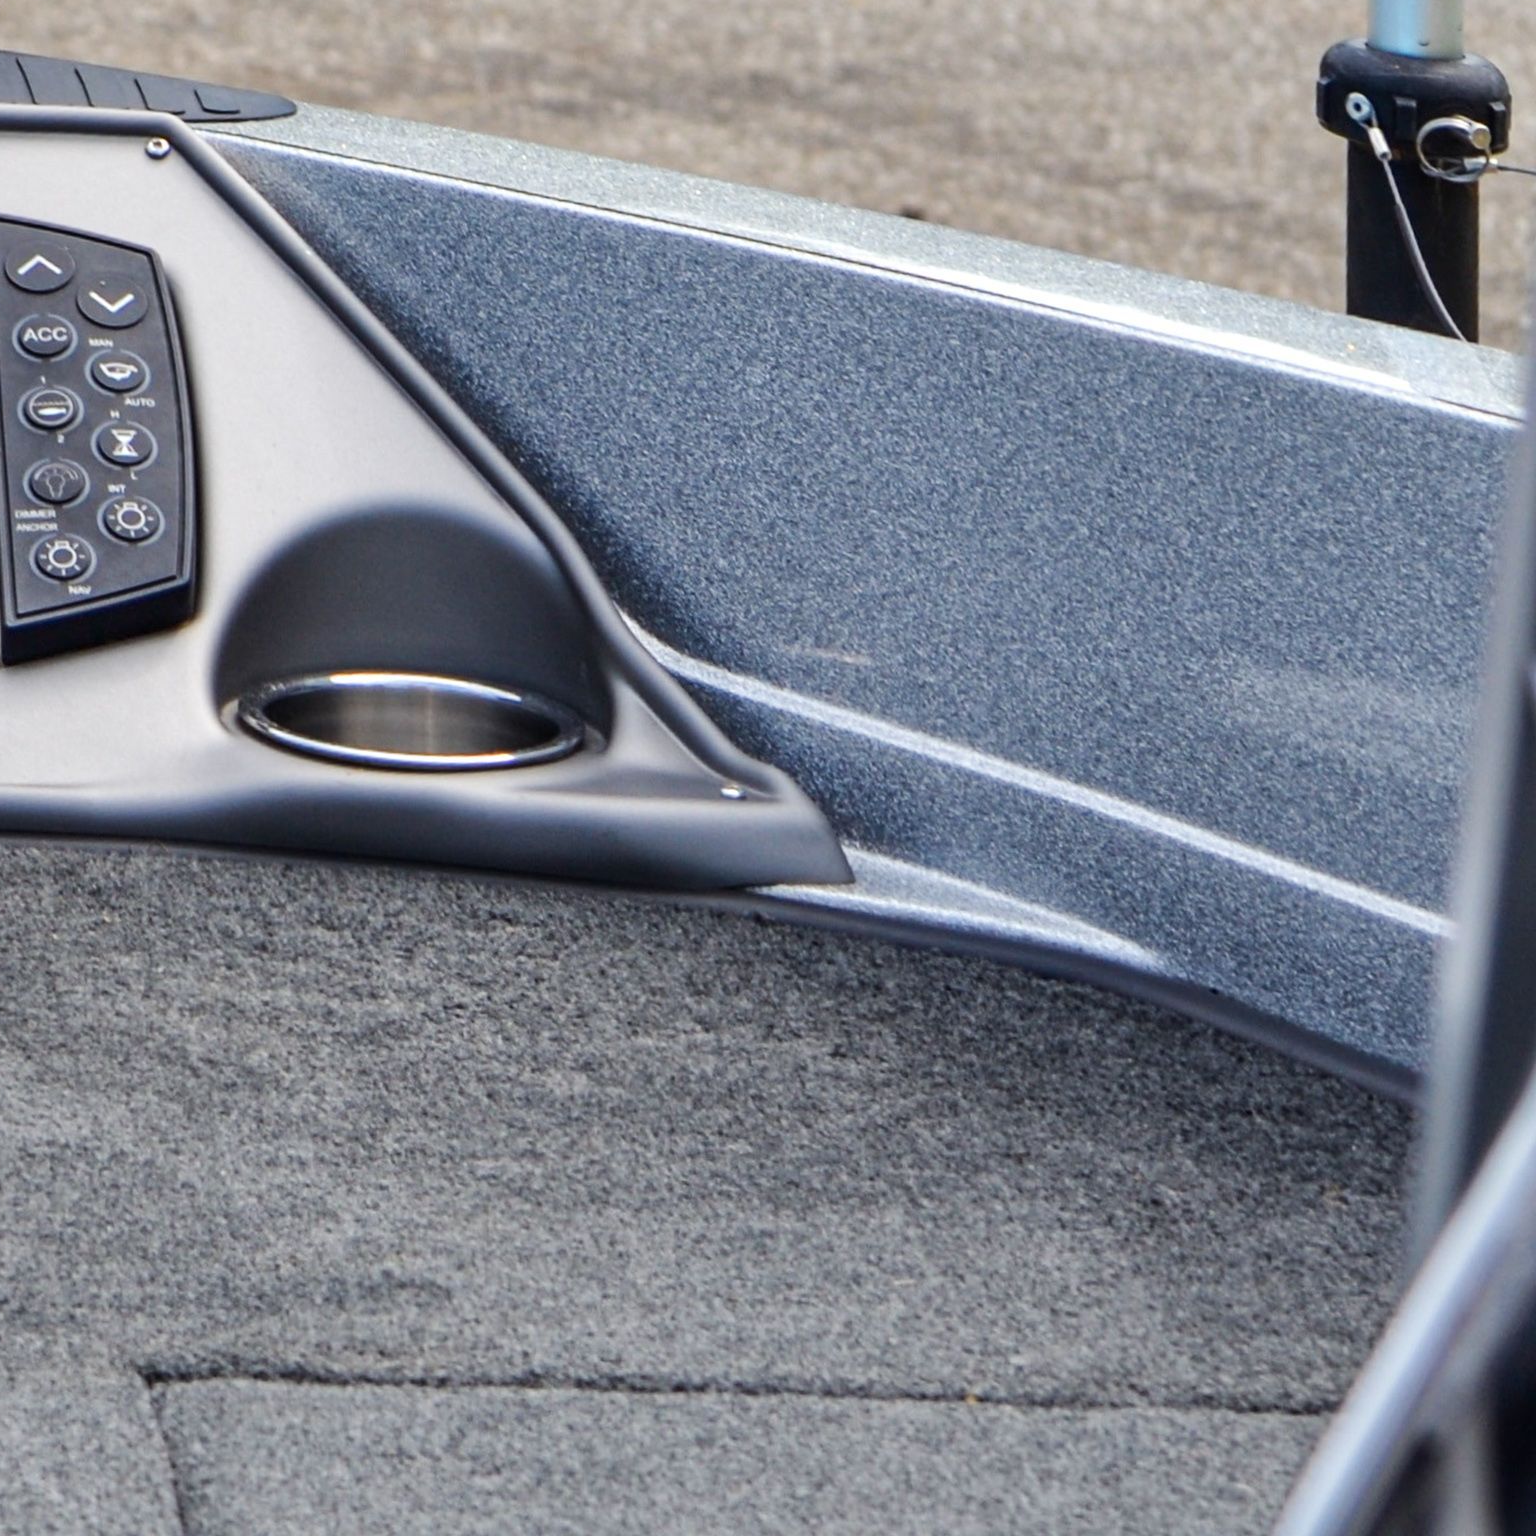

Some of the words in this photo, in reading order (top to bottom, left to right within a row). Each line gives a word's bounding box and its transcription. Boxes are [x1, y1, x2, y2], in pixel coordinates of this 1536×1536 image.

[23, 327, 68, 342] ACC
[88, 338, 114, 348] MAN
[124, 397, 156, 408] AUTO
[14, 509, 57, 519] DIMMER
[15, 522, 59, 532] ANCHOR
[67, 585, 92, 595] NAV
